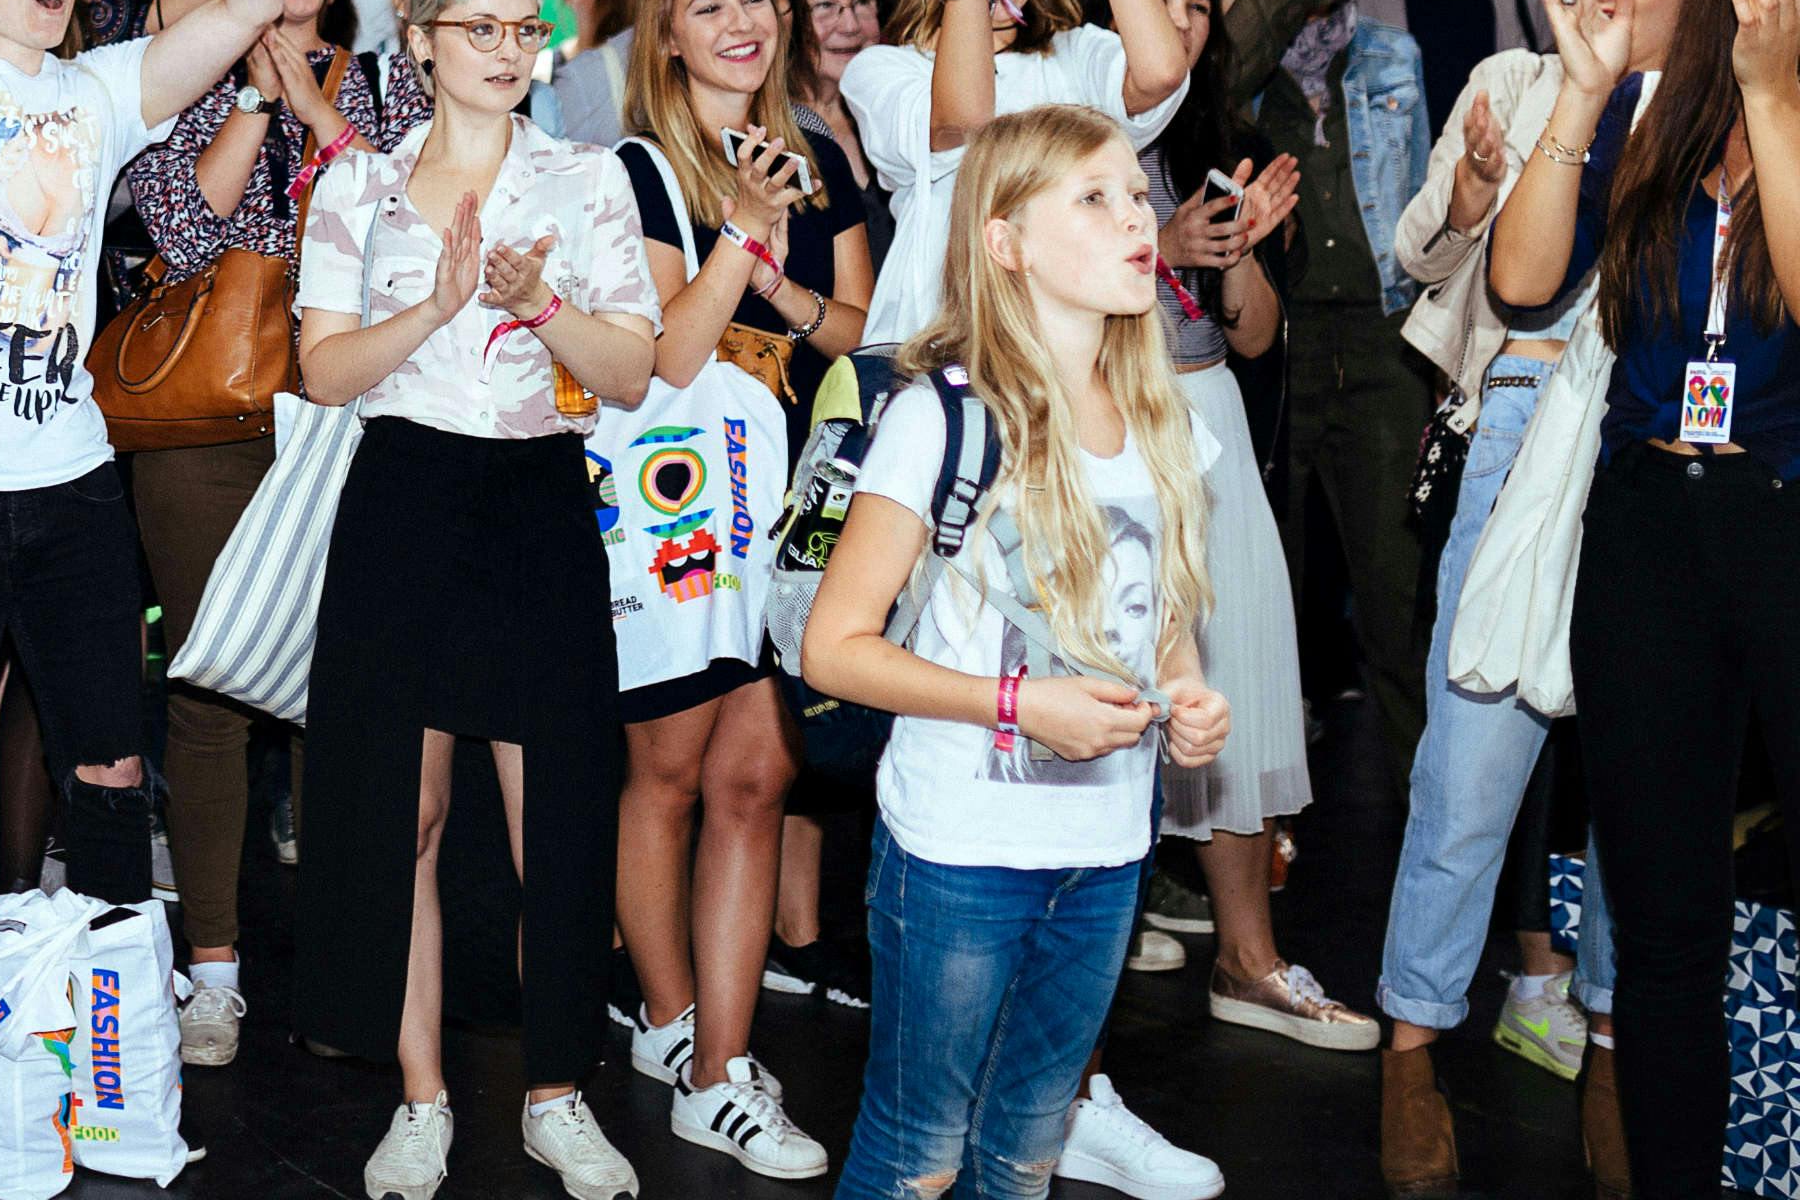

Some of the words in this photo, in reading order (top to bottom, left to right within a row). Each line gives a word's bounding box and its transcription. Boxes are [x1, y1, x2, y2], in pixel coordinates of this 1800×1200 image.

[12, 387, 62, 425] UP!
[723, 415, 754, 560] FASHION
[601, 527, 626, 547] SIC
[92, 967, 125, 1110] FASHION
[70, 1125, 121, 1142] FOOD
